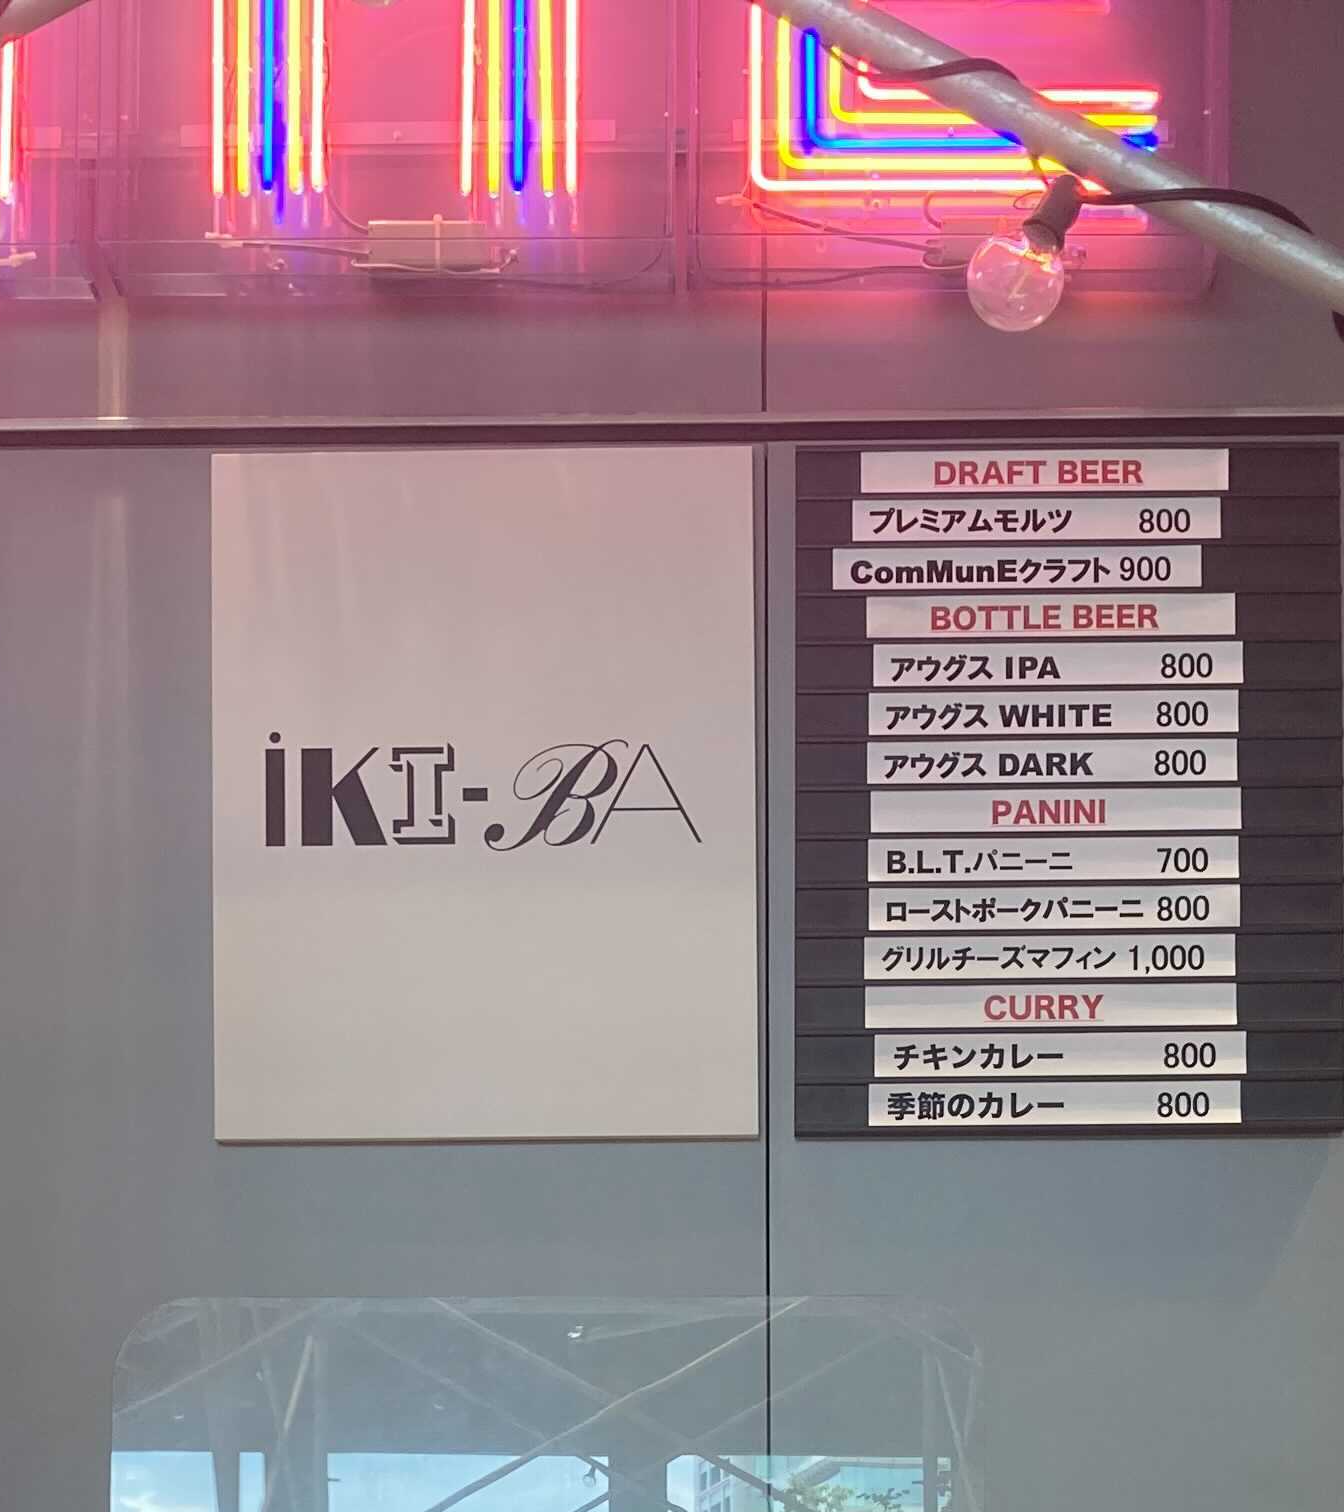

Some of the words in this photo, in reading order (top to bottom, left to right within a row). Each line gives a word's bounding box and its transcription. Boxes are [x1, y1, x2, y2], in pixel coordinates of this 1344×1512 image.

[933, 460, 1046, 485] DRAFT
[1058, 460, 1143, 484] BEER
[869, 508, 1072, 535] プレミアムモルツ
[1139, 509, 1190, 533] 800
[850, 558, 1110, 584] ComMunEクラフト
[1119, 556, 1171, 581] 900
[931, 606, 1060, 630] BOTTLE
[1072, 604, 1159, 629] BEER
[891, 656, 993, 681] アウグス
[1006, 656, 1060, 679] IPA
[1160, 653, 1213, 678] 800
[885, 703, 989, 729] アウグス
[999, 703, 1112, 727] WHITE
[1156, 701, 1208, 727] 800
[884, 753, 985, 778] アウグス
[998, 752, 1093, 776] DARK
[1154, 750, 1206, 775] 800
[991, 799, 1107, 825] PANINI
[1156, 848, 1208, 872] 700
[886, 898, 1143, 923] ローストポークパニーニ
[1156, 896, 1209, 921] 800
[882, 946, 1116, 972] グリルチーズマフィン
[1129, 946, 1205, 974] 1,000
[983, 994, 1103, 1020] CURRY
[894, 1043, 1063, 1070] チキンカレー
[1163, 1043, 1216, 1067] 800
[888, 1092, 1064, 1121] 季節のカレー
[1156, 1092, 1209, 1117] 800
